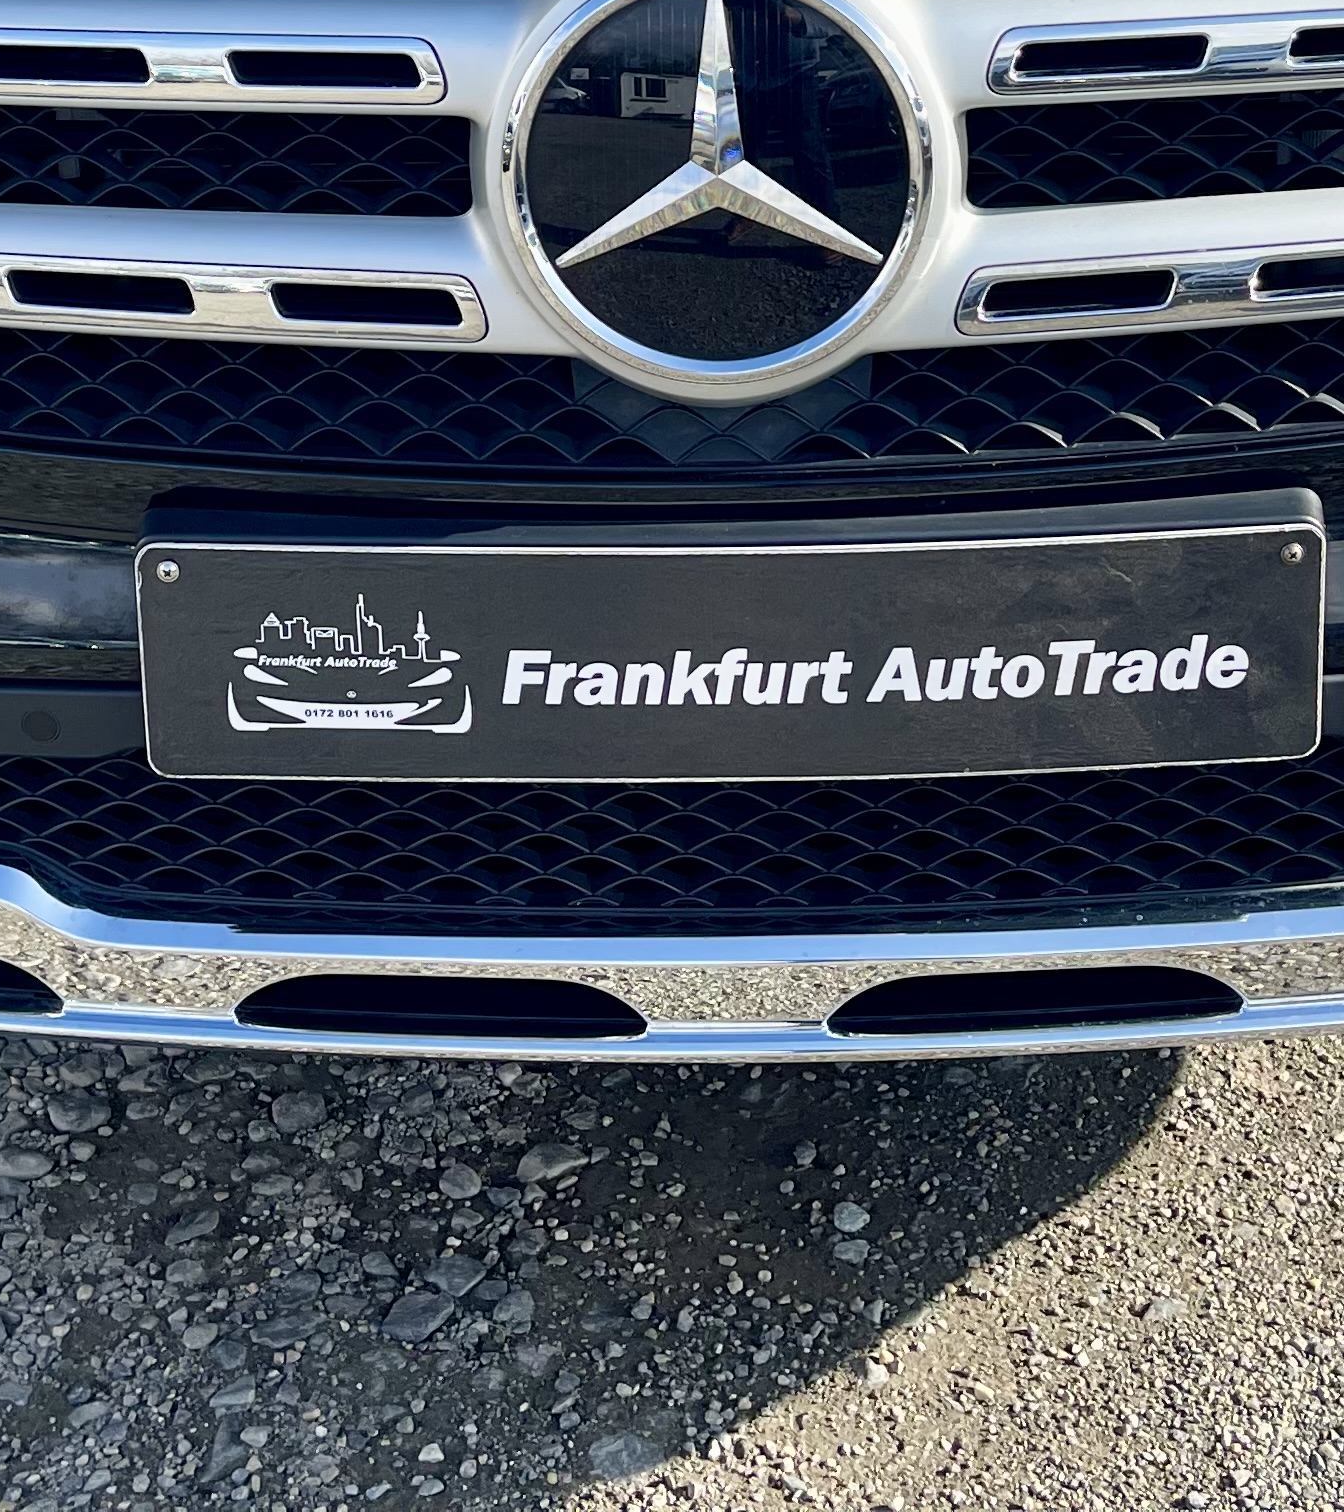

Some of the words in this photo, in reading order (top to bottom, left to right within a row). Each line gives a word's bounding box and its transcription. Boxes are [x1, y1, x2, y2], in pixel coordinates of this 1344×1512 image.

[258, 655, 323, 667] Frankfurt
[323, 656, 398, 668] AutoTrade
[501, 647, 853, 707] Frankfurt
[866, 633, 1251, 705] AutoTrade
[304, 709, 334, 718] 0172
[338, 709, 359, 718] 801
[364, 709, 394, 718] 1616
